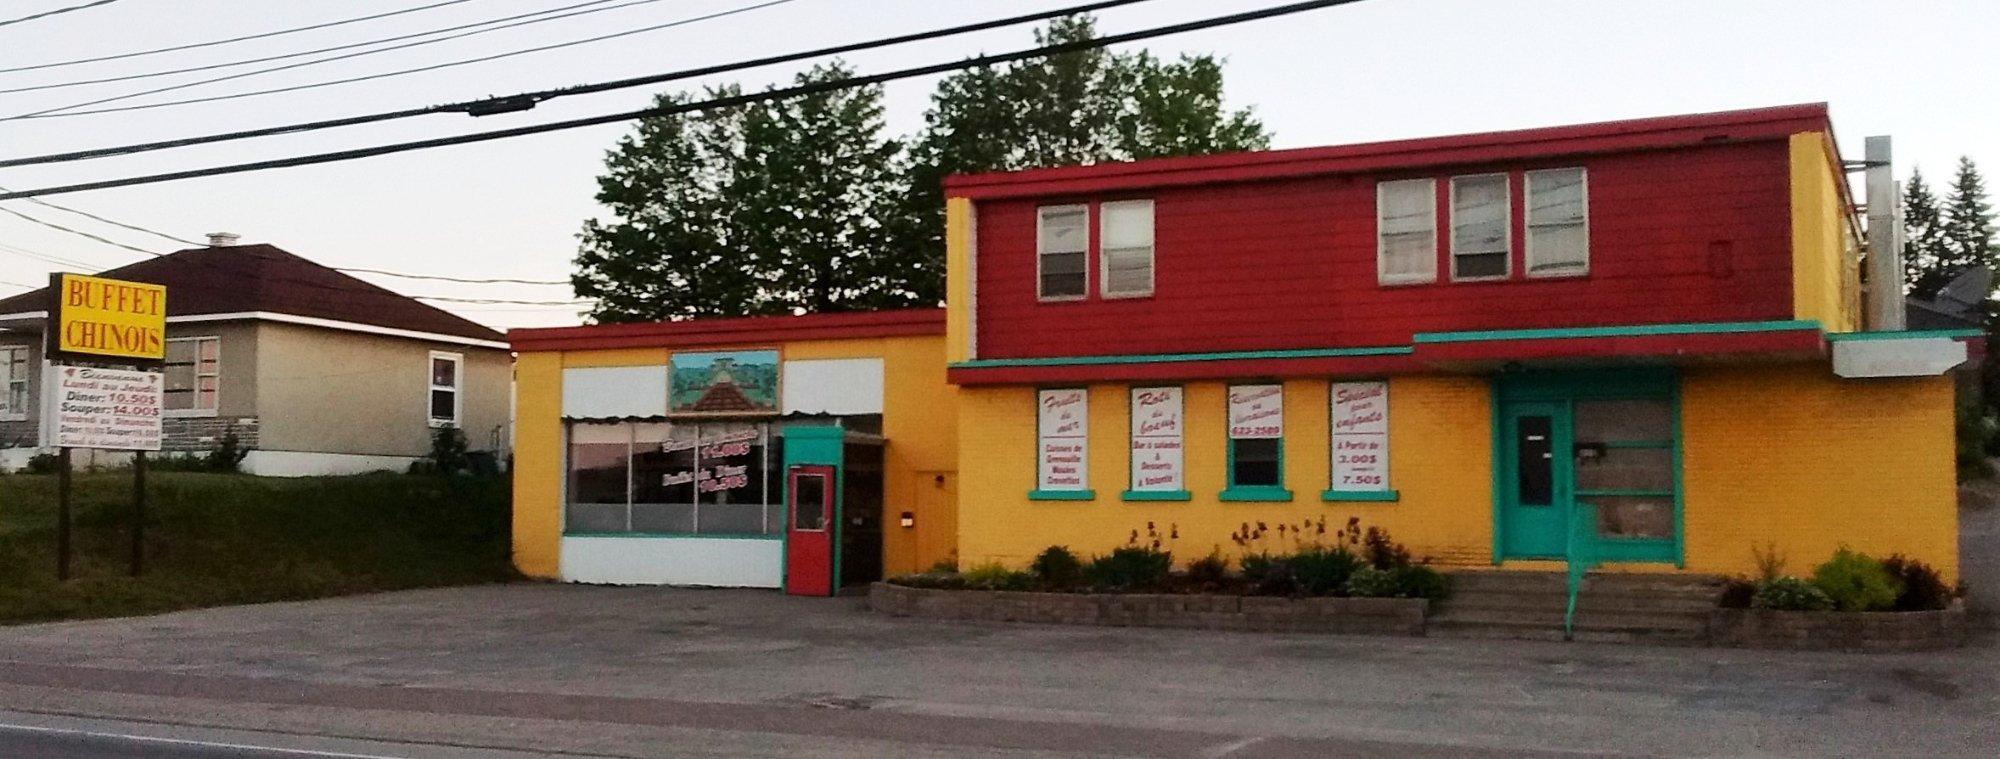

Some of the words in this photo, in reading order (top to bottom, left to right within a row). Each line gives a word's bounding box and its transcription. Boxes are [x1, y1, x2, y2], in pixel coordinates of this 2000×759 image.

[68, 279, 161, 316] BUFFET
[66, 320, 160, 354] CHINOIS
[62, 379, 99, 389] Lundi
[108, 393, 157, 405] 10.50$
[113, 405, 160, 417] 14.00$
[1336, 411, 1382, 430] enfants
[1343, 475, 1381, 485] 7.50$
